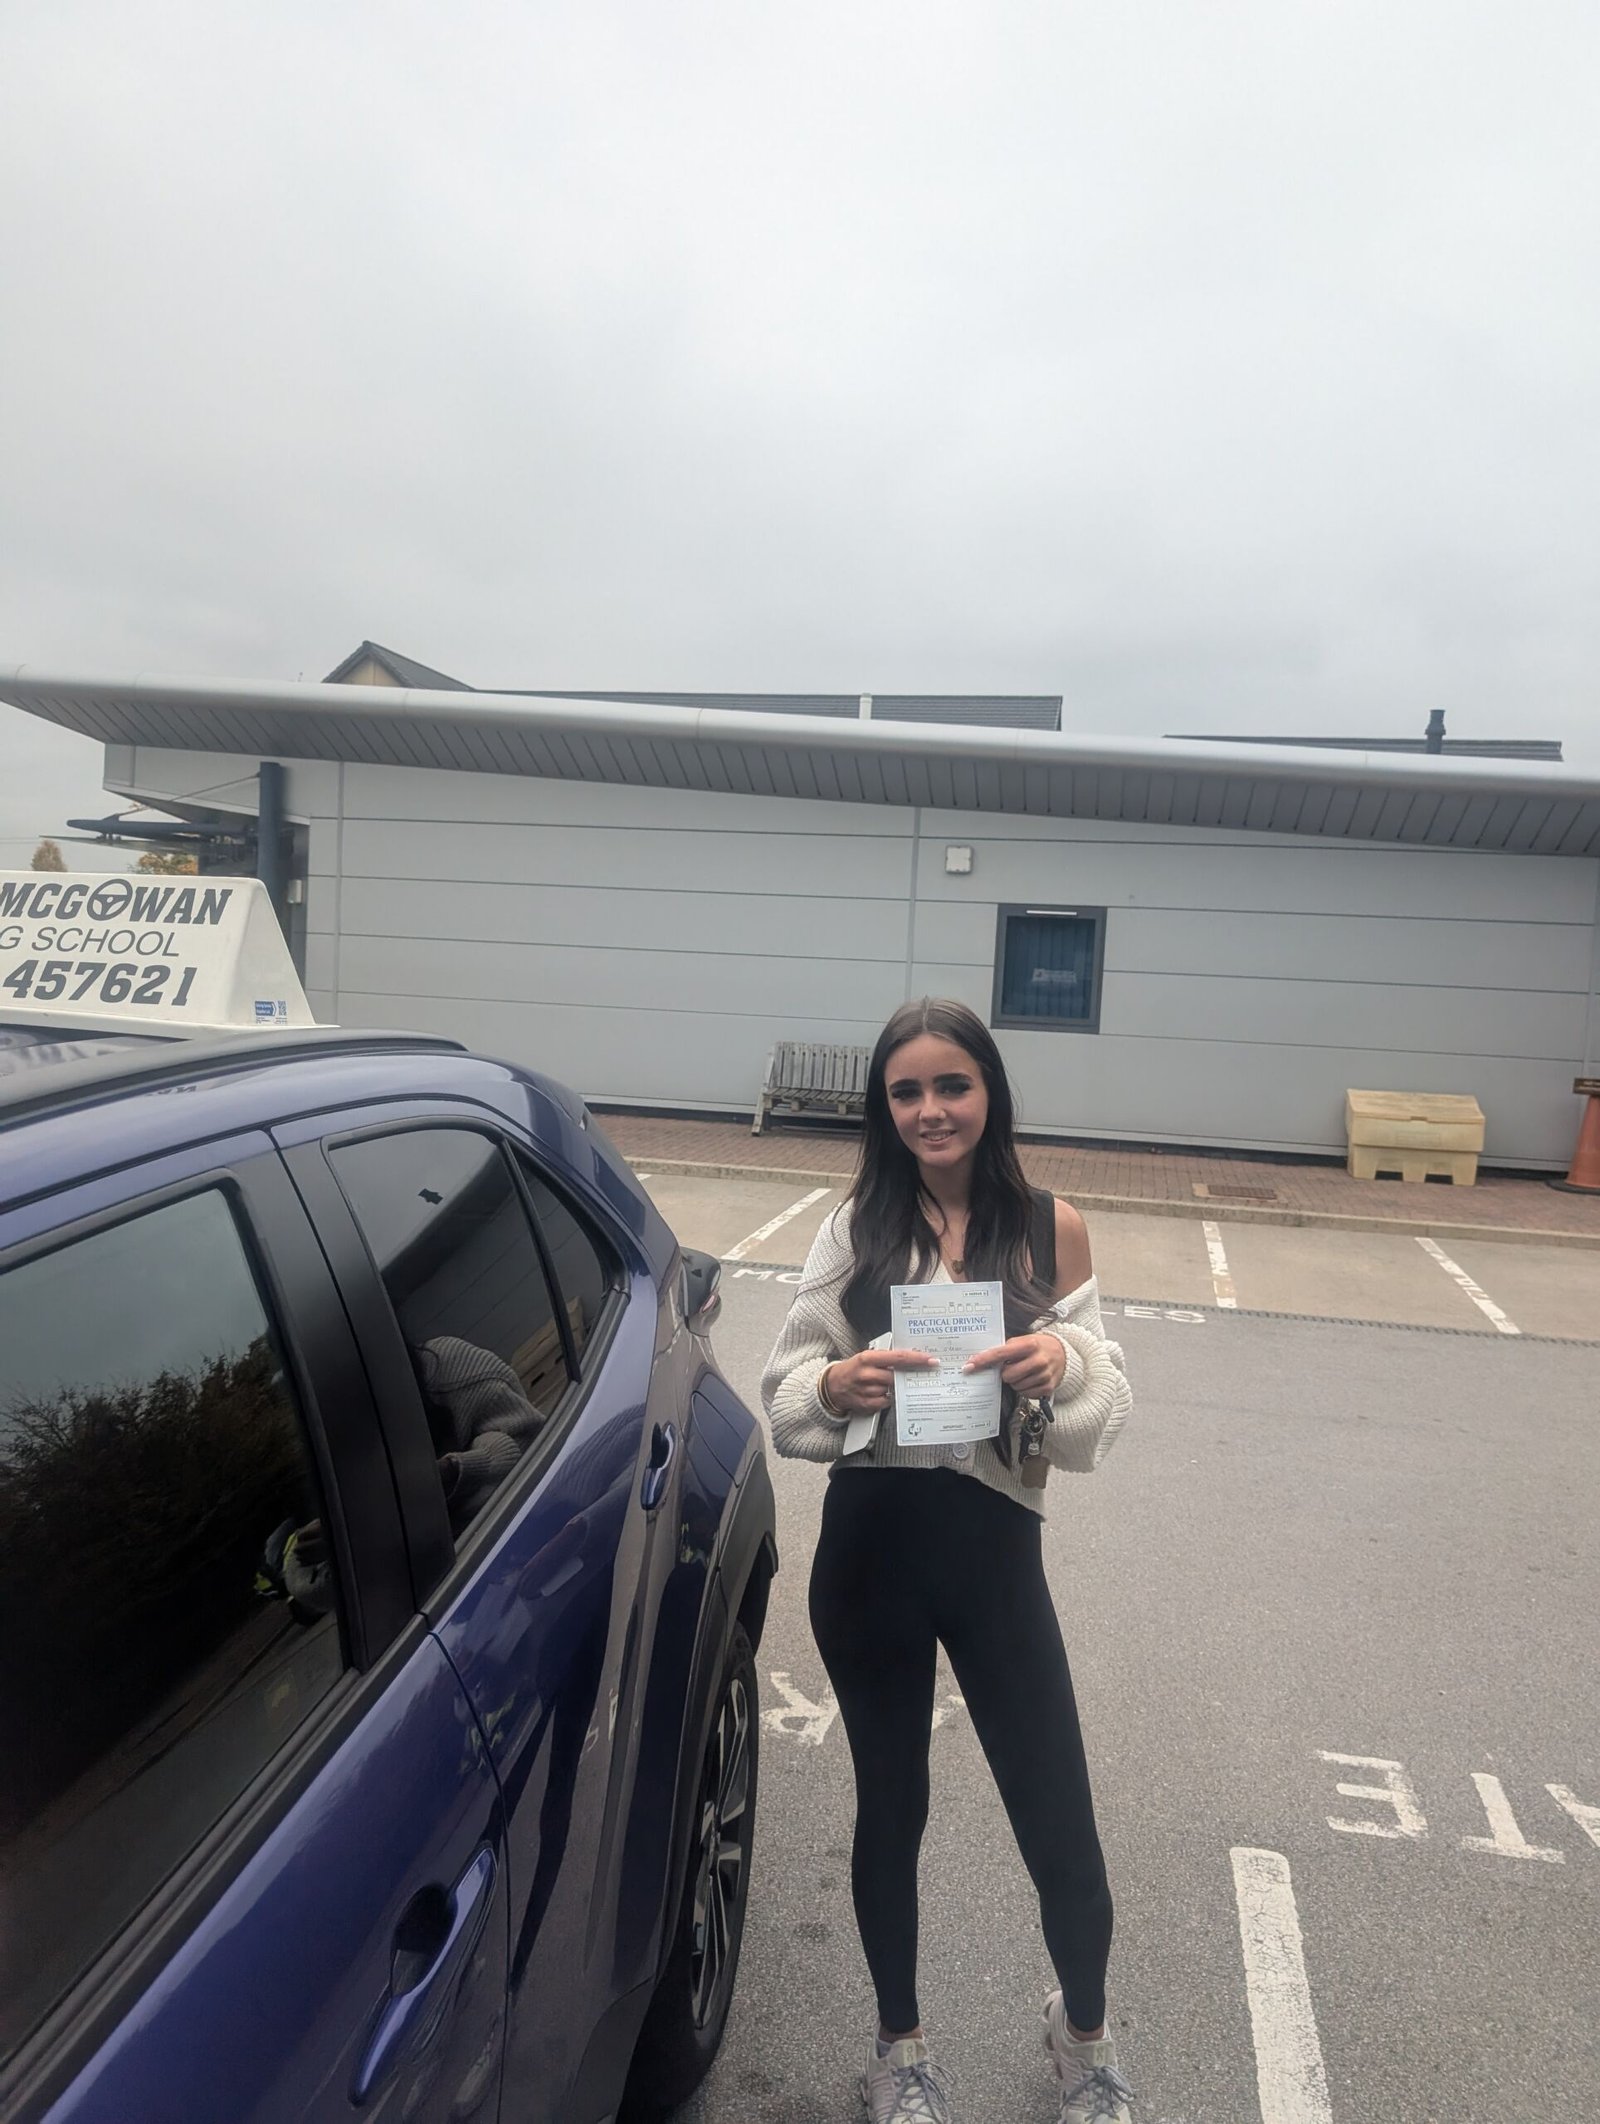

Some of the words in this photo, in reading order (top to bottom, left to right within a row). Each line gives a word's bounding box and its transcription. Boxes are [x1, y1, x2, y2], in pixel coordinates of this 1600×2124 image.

[31, 926, 180, 957] SCHOOL
[2, 959, 198, 1006] 457621
[908, 1318, 950, 1327] PRACTICAL
[952, 1316, 987, 1325] DRIVING
[909, 1327, 925, 1335] TEST
[927, 1326, 943, 1334] PASS
[944, 1324, 987, 1333] CERTIFICATE
